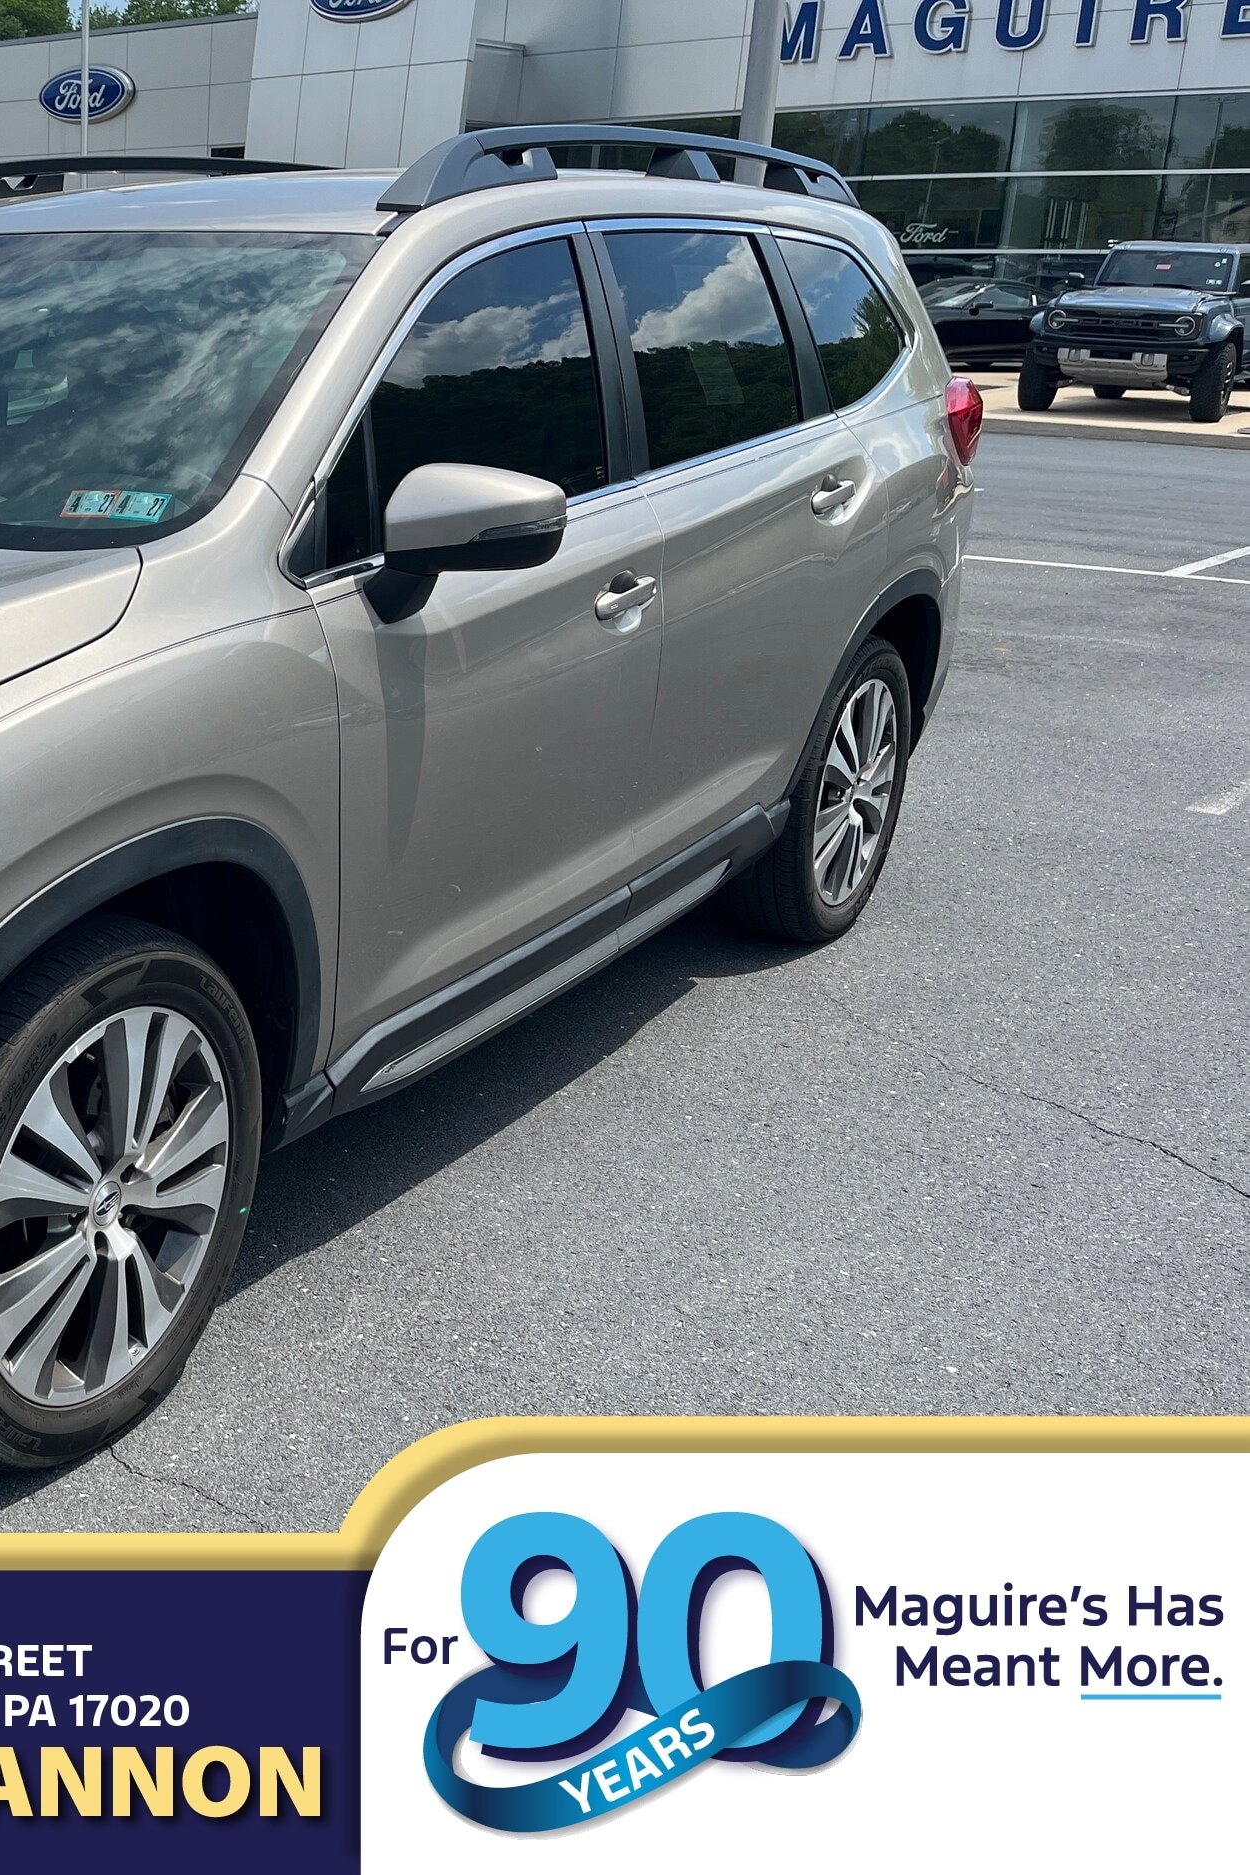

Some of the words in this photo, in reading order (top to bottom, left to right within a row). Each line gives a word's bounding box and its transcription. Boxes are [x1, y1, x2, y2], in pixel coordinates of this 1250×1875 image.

[54, 79, 106, 111] Fod
[900, 222, 948, 243] Ford
[146, 497, 167, 517] 27
